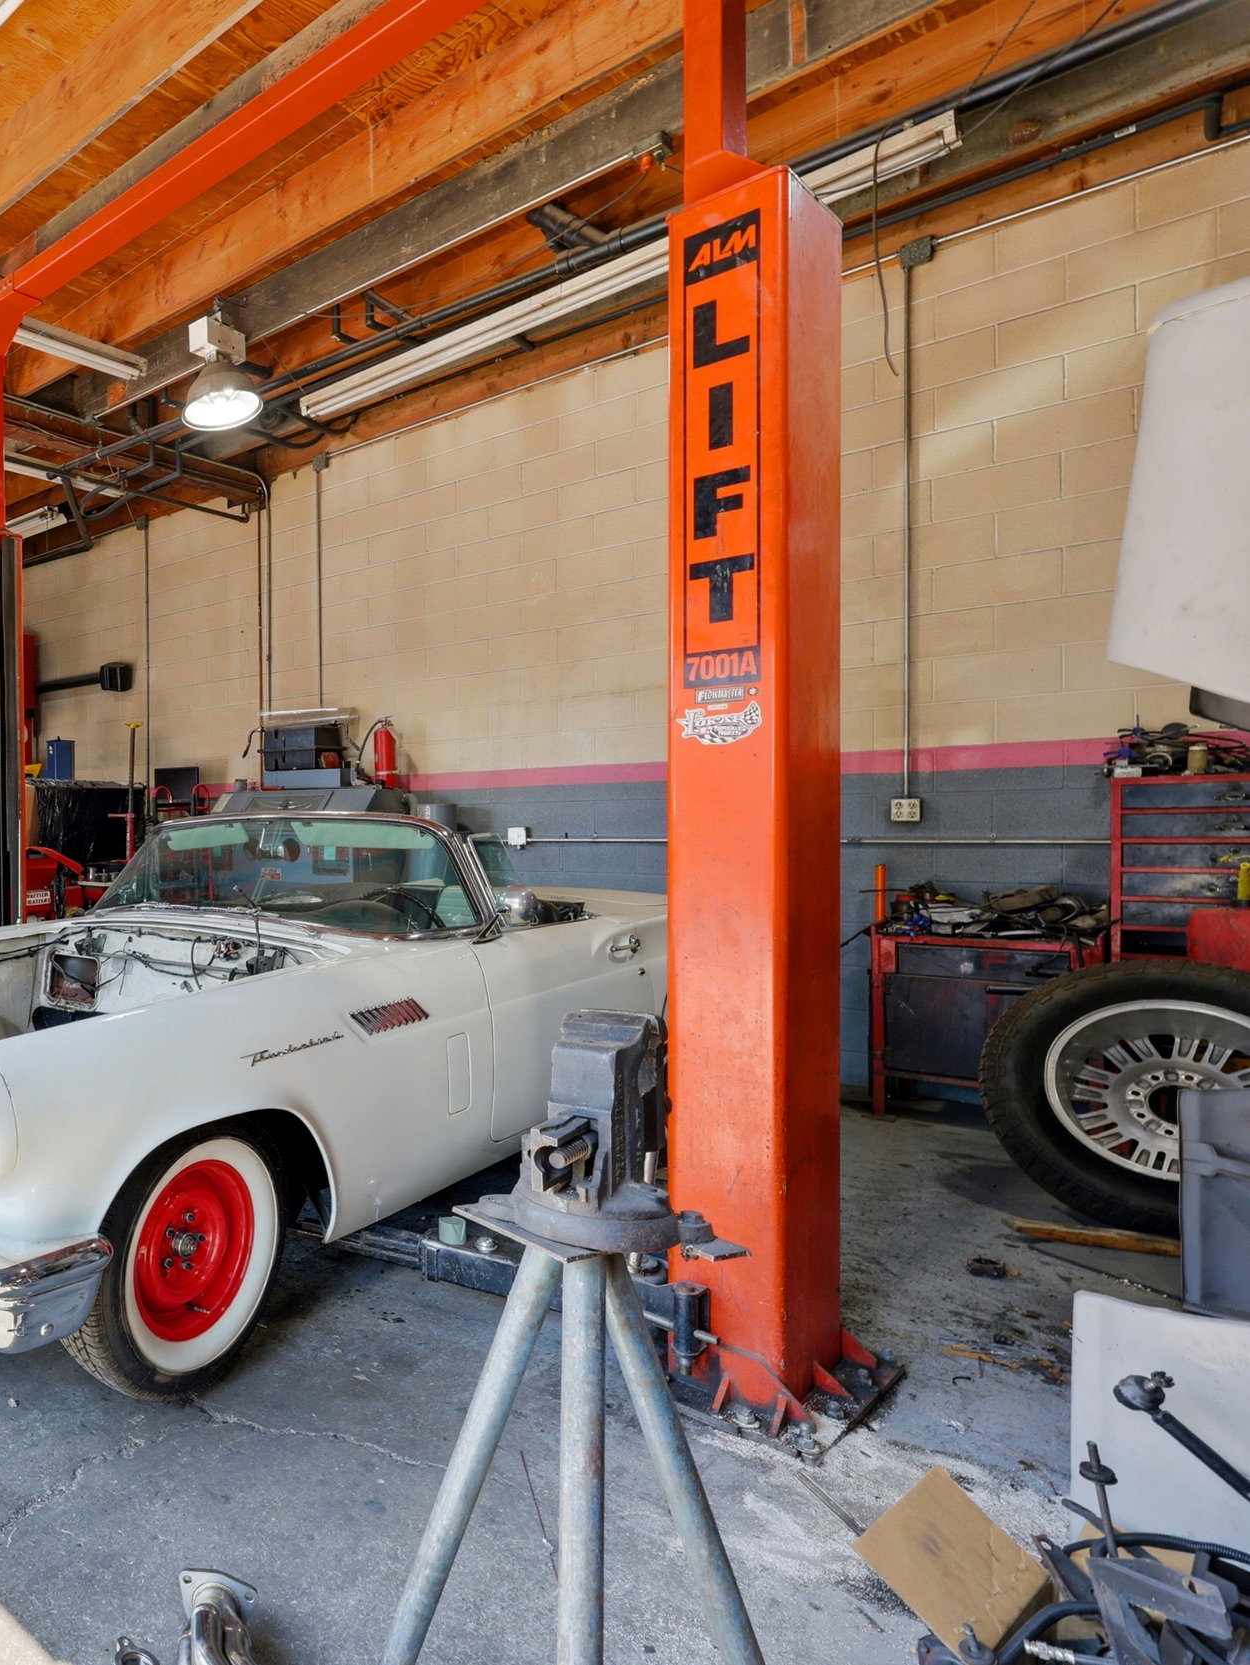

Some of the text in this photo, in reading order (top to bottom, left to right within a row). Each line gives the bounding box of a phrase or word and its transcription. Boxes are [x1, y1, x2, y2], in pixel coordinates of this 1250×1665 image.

[688, 224, 756, 272] ALM
[689, 300, 755, 624] LIFT
[686, 650, 757, 681] 7001A
[698, 688, 743, 702] FLOWMASTER
